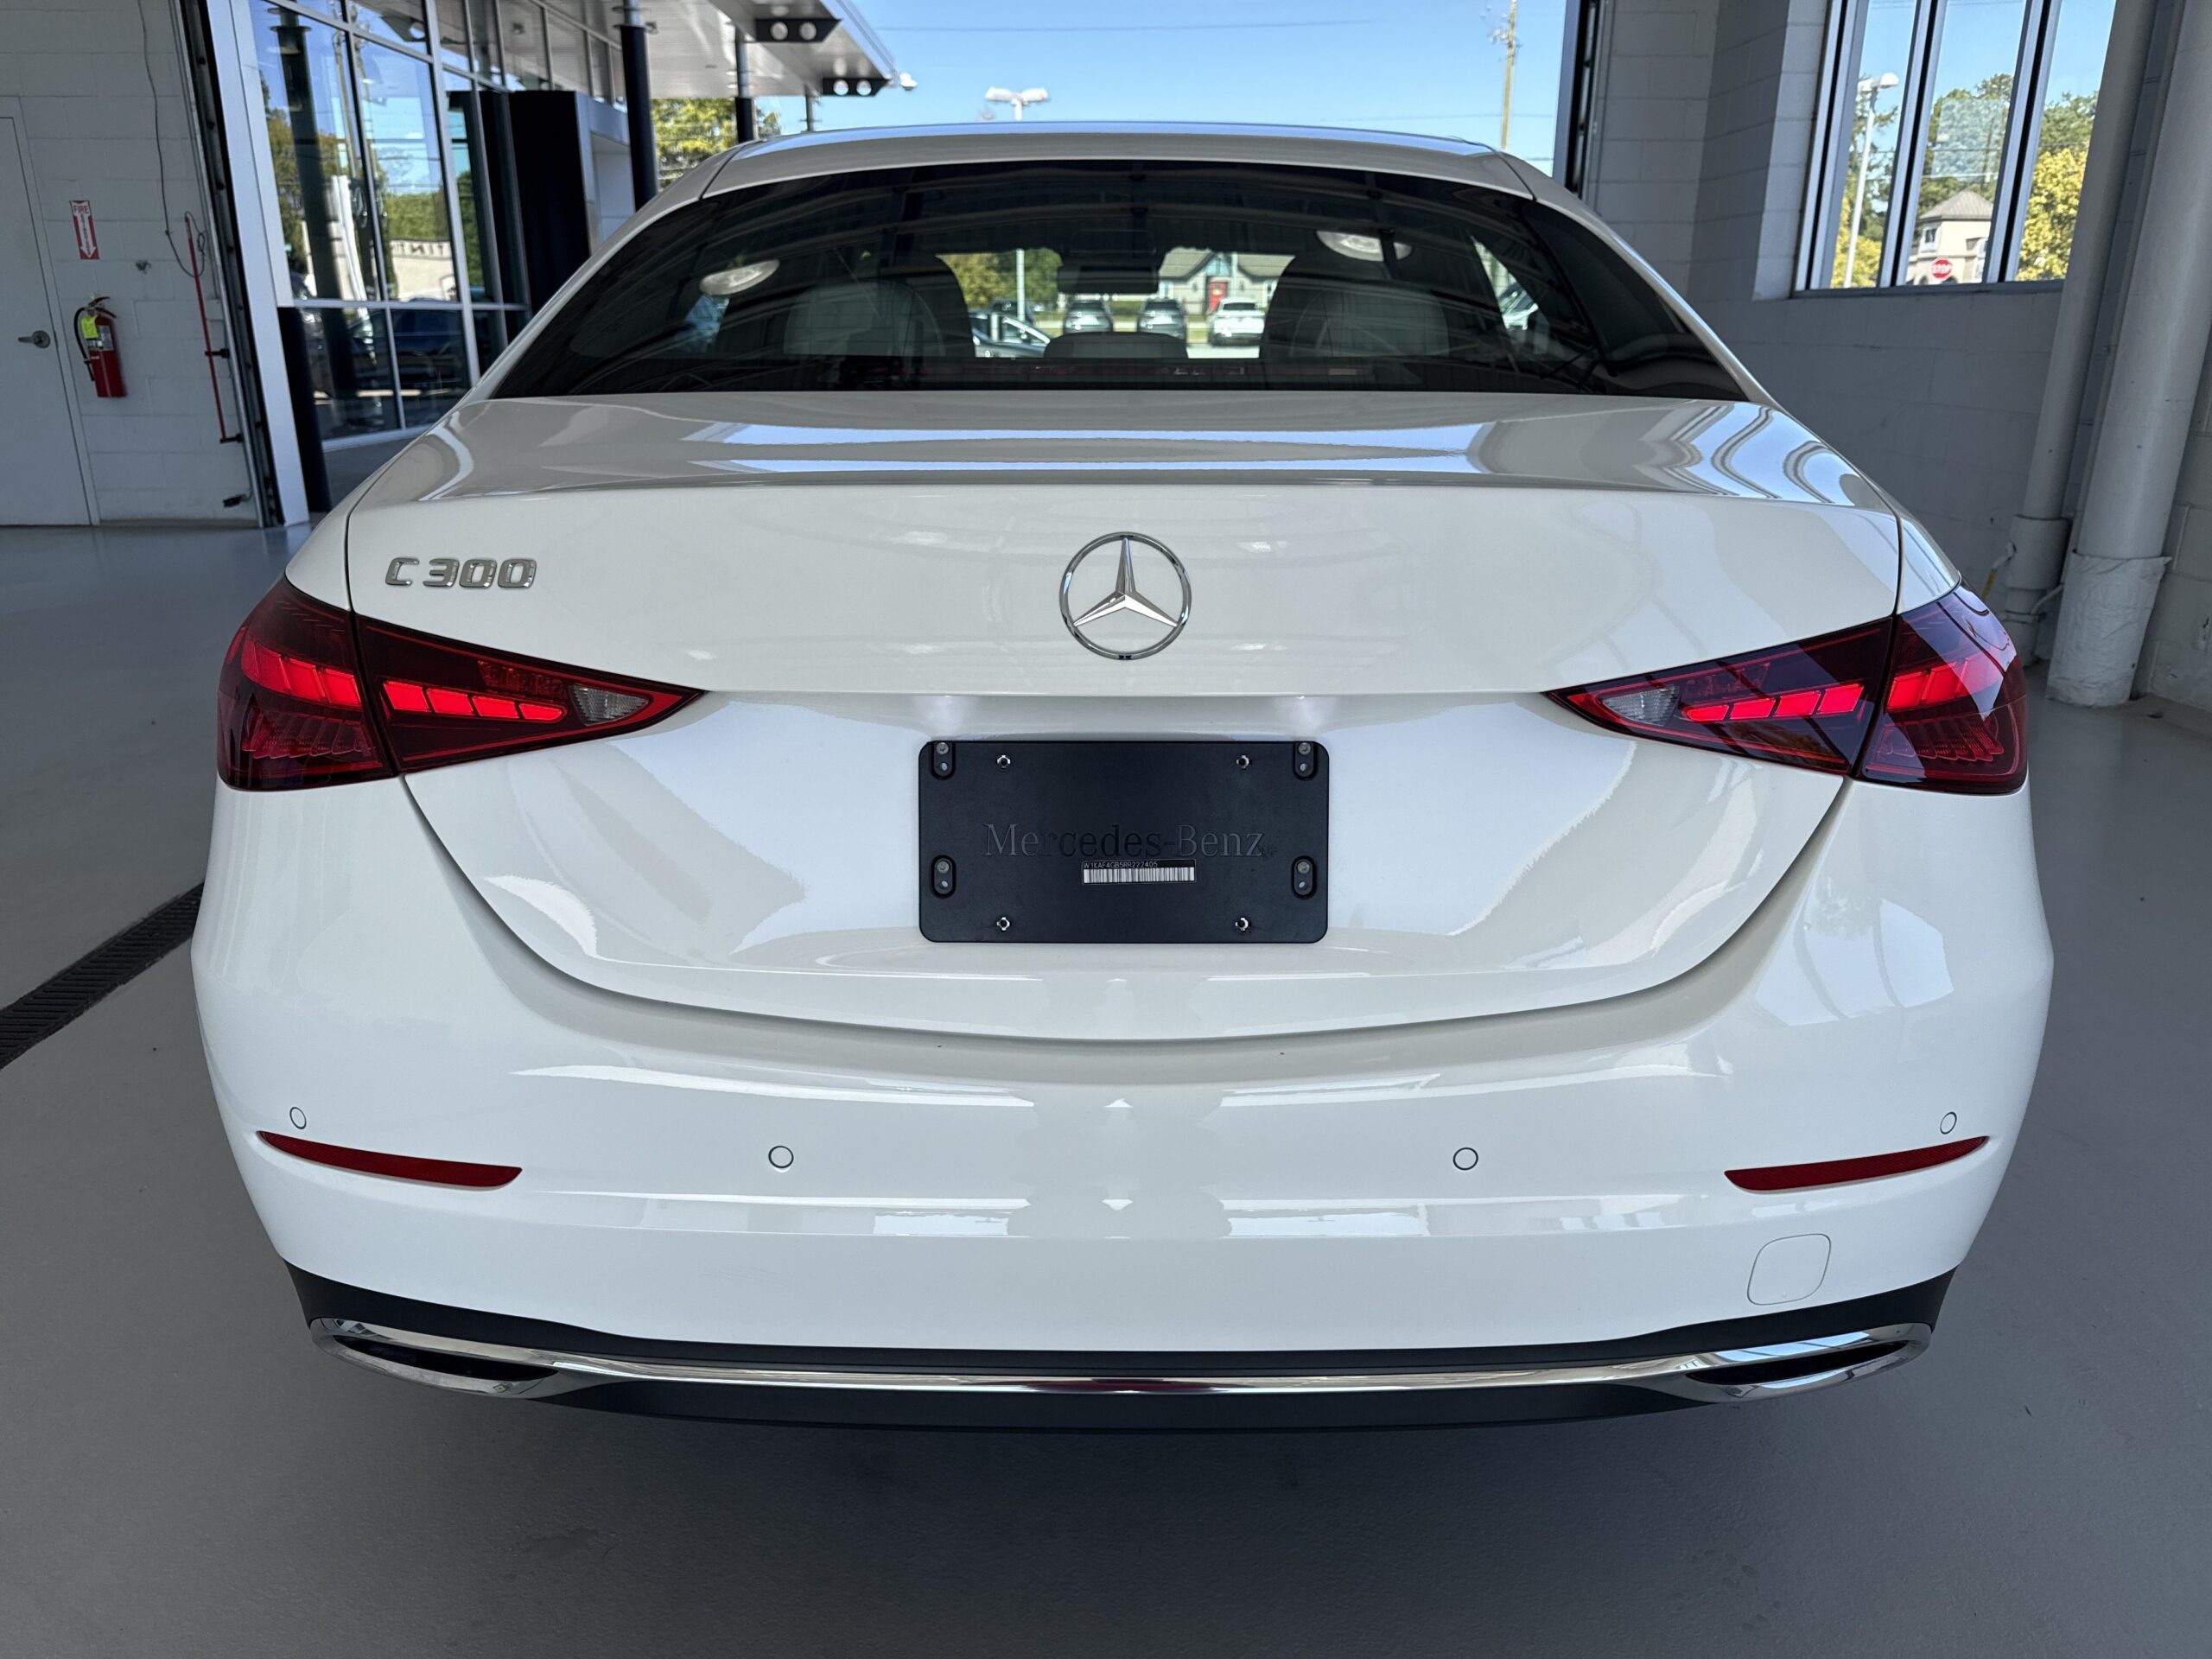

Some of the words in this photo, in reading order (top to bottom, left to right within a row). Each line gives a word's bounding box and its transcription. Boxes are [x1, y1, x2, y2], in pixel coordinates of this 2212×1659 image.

[73, 205, 90, 214] FIRE
[1931, 263, 1952, 274] STOP
[385, 556, 420, 587] C
[423, 558, 537, 588] 300
[984, 823, 1265, 858] Mercedes-Benz
